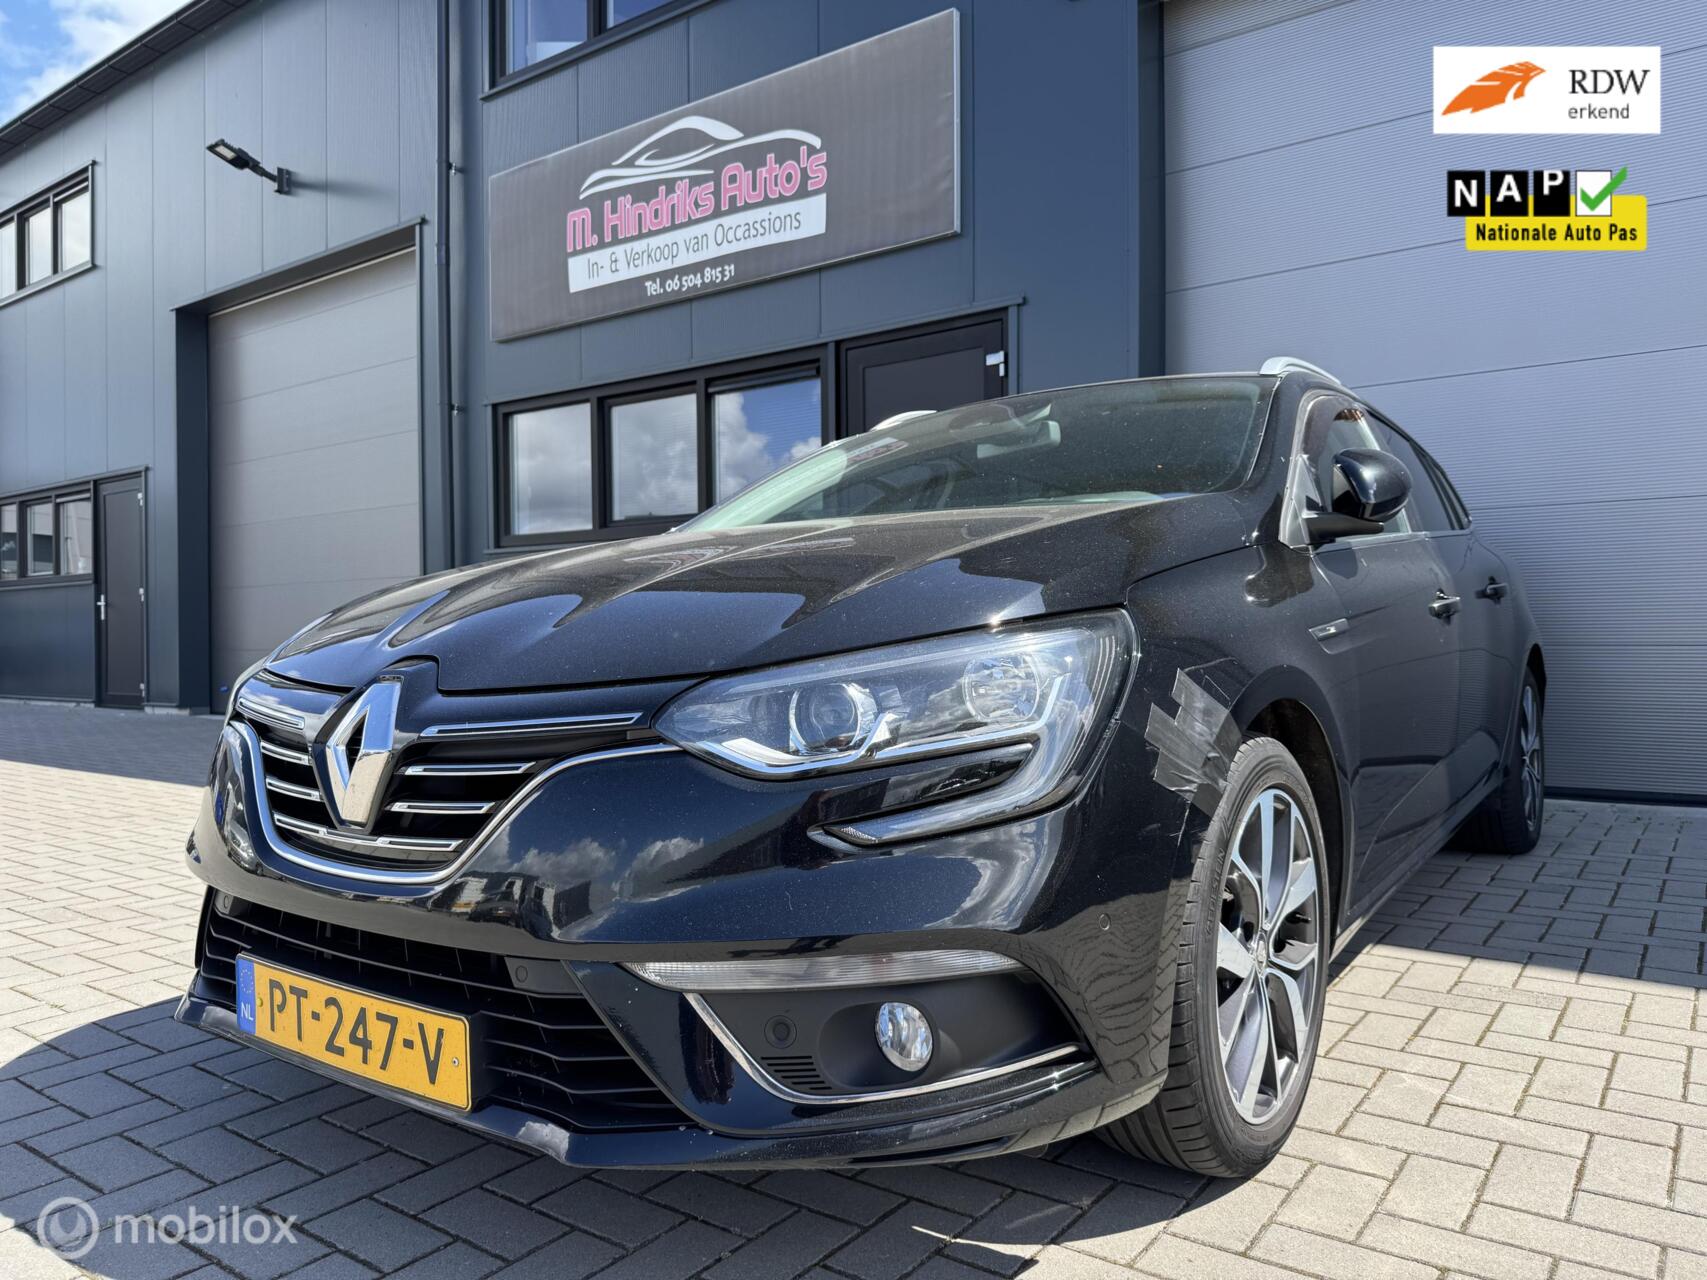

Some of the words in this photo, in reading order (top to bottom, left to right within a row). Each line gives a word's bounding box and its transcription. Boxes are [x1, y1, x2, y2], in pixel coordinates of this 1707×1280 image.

[566, 207, 598, 252] M.
[604, 179, 714, 242] Hindriks
[720, 145, 827, 210] Auto's
[587, 257, 604, 280] In-
[609, 251, 620, 275] &
[624, 240, 679, 270] Verkoop
[683, 232, 709, 256] van
[714, 210, 801, 247] Occassions
[645, 276, 664, 297] Tel.
[665, 275, 680, 292] 06
[724, 264, 735, 280] 31
[241, 1002, 253, 1020] NL
[269, 978, 444, 1085] PT-247-V
